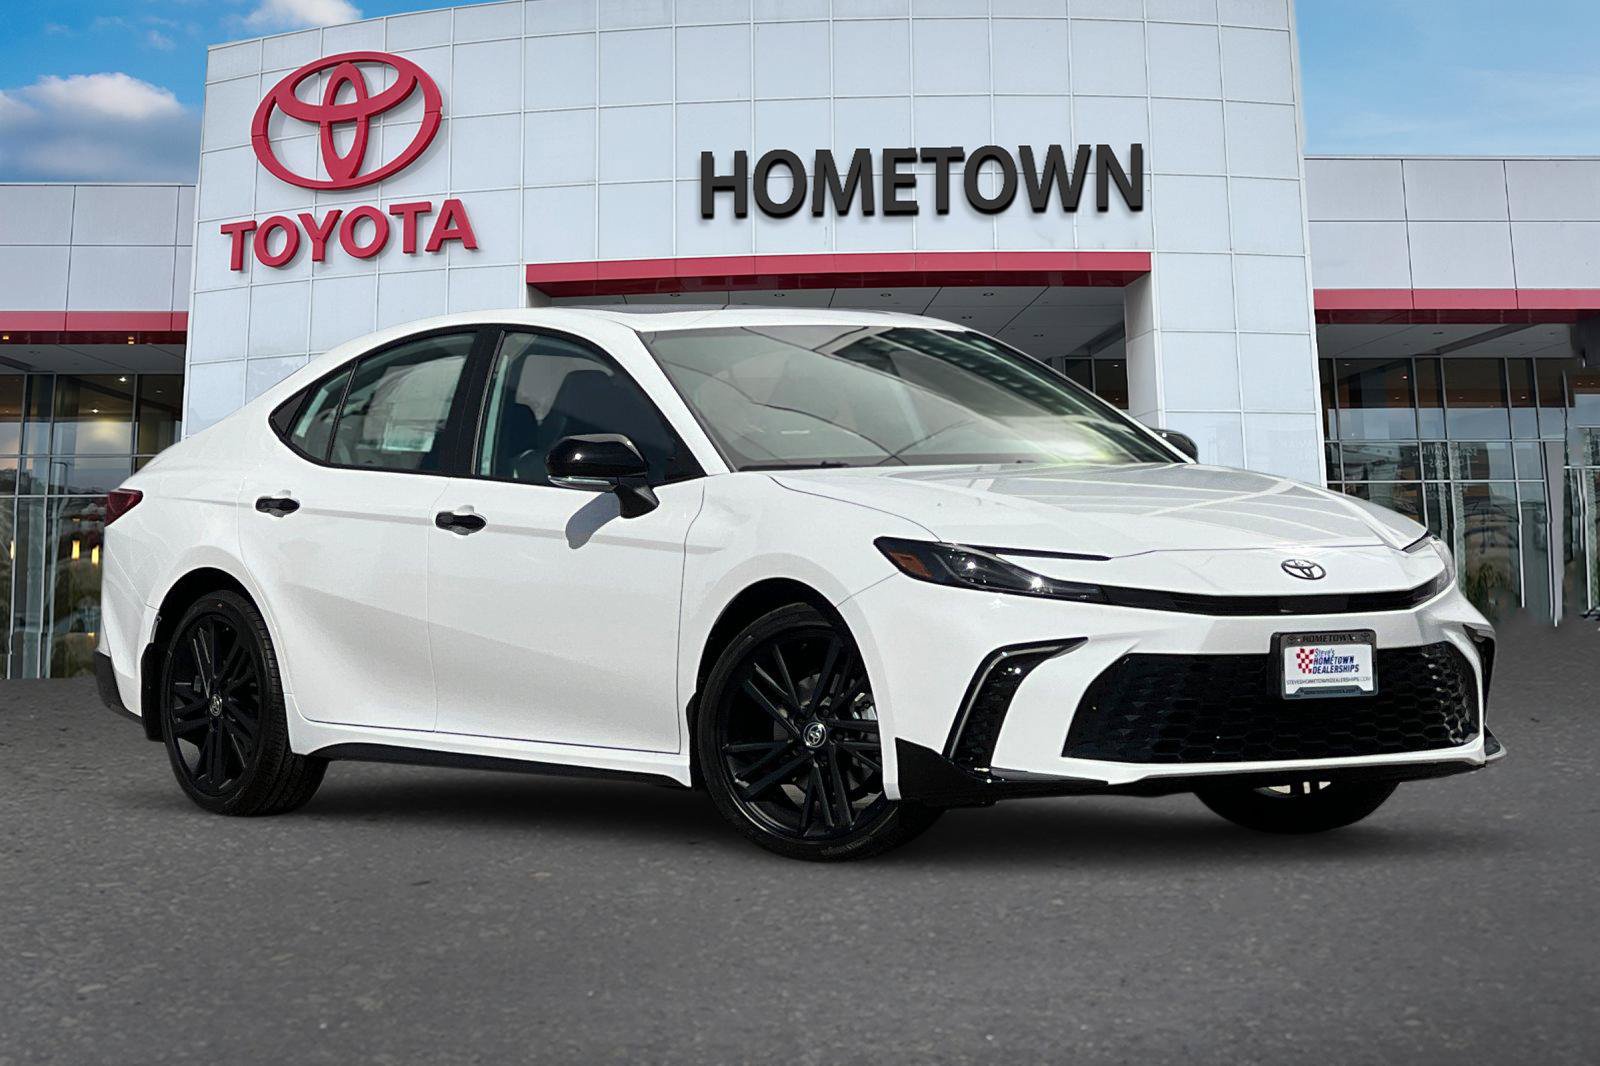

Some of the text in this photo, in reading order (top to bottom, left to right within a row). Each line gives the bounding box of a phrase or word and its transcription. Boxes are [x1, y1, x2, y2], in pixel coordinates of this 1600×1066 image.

[700, 143, 1144, 219] HOMETOWN
[220, 198, 479, 271] TOYOTA
[1302, 634, 1352, 642] HOMETOWN
[1314, 648, 1335, 658] Steve's
[1313, 656, 1354, 665] HOMETOWN
[1312, 664, 1360, 674] DEALERSHIPS
